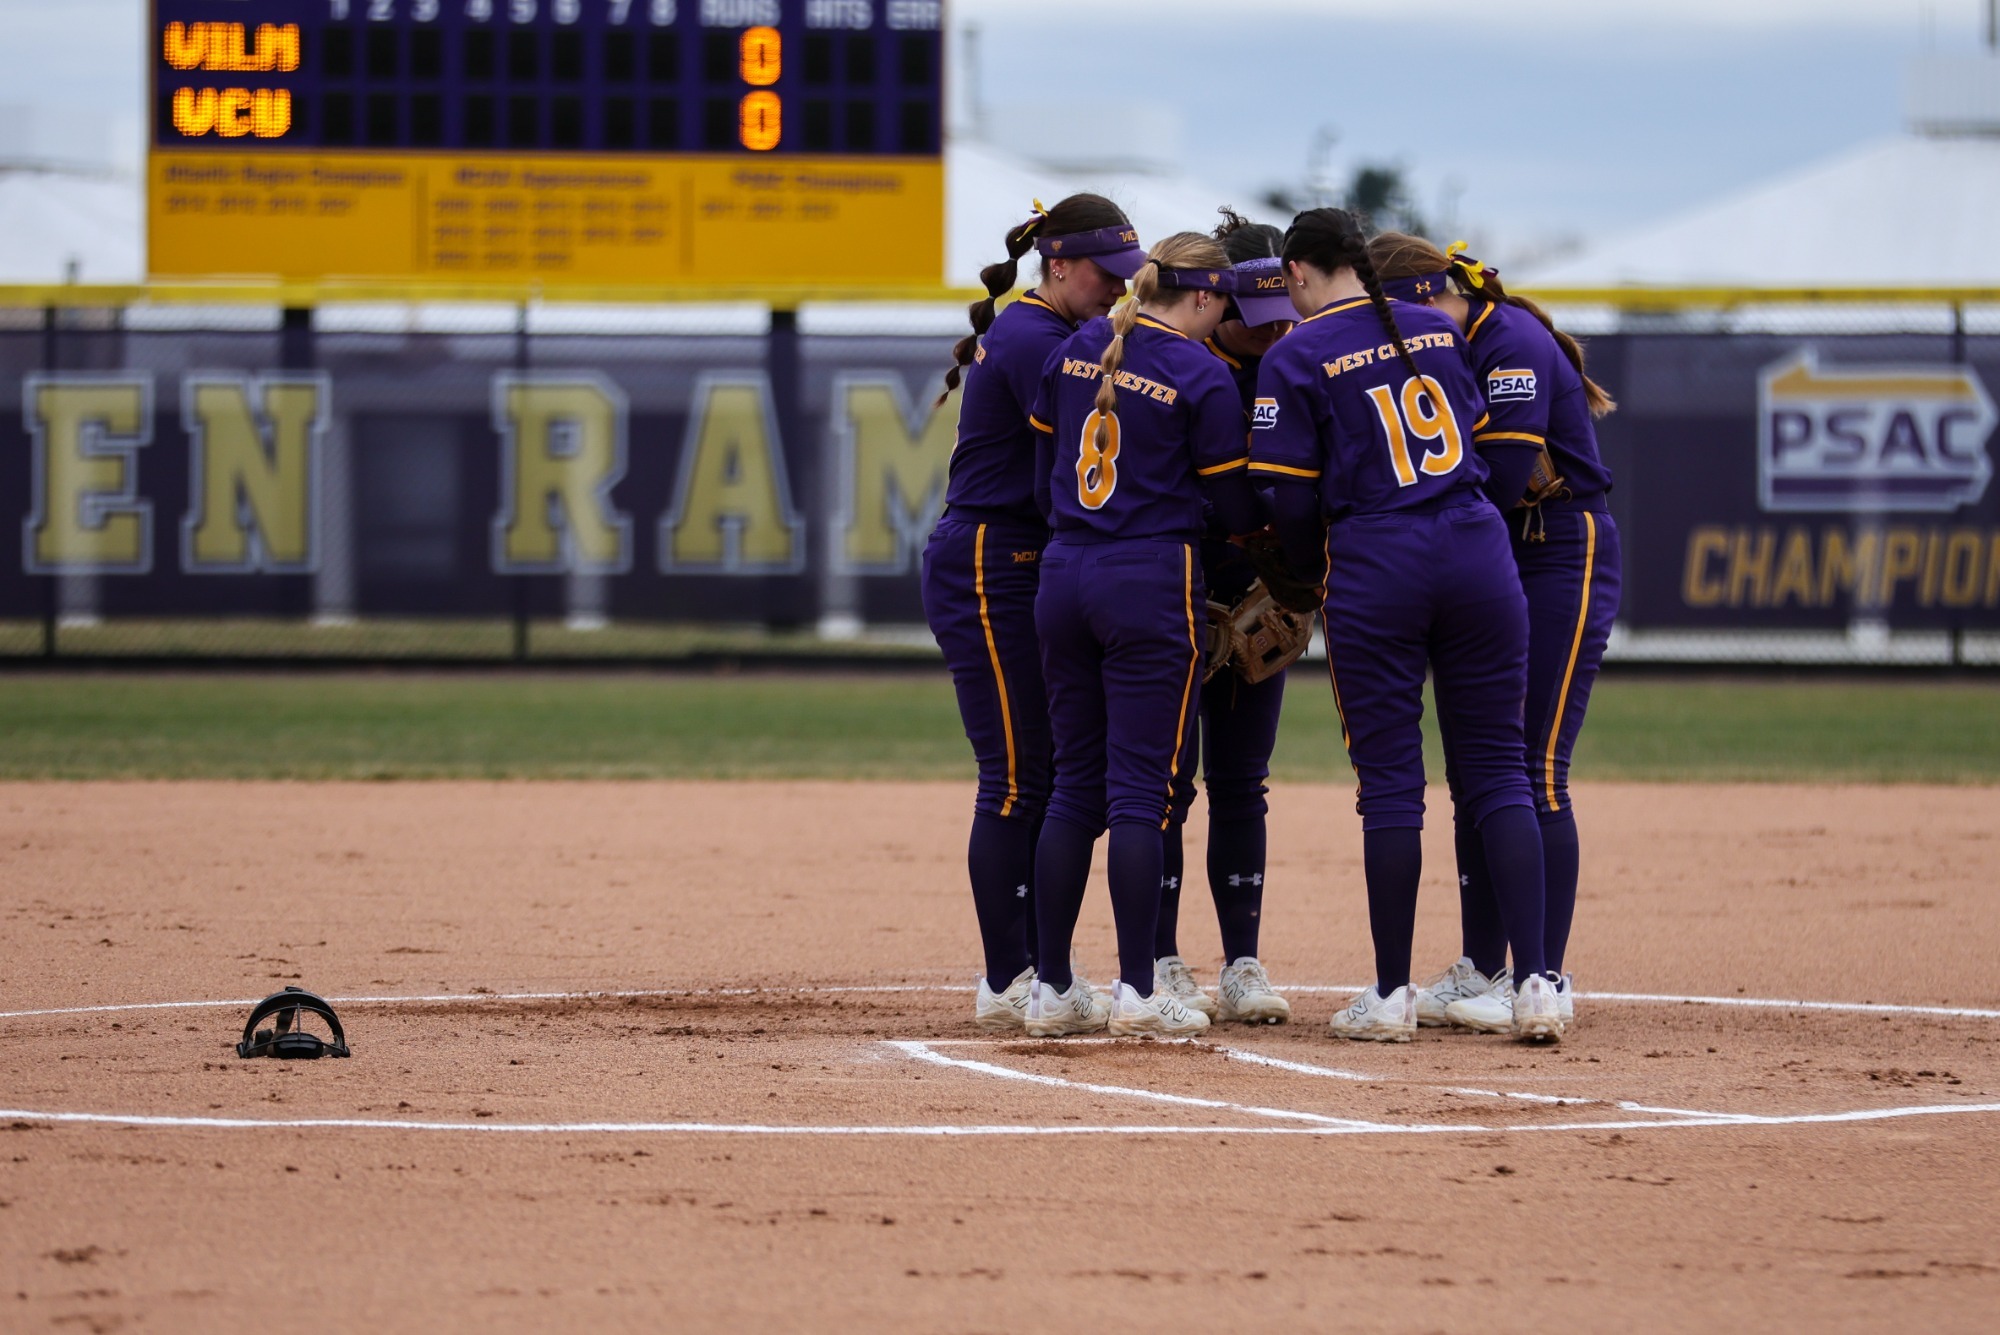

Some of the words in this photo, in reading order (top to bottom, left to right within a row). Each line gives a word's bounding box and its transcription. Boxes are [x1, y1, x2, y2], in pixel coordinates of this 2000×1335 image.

[366, 0, 395, 22] 2
[410, 0, 439, 23] 3
[806, 0, 873, 29] HITS
[739, 26, 782, 85] 0
[739, 90, 782, 150] 0
[1119, 230, 1138, 243] WC
[1062, 357, 1103, 380] WEST
[1103, 369, 1178, 406] HESTER
[1322, 348, 1374, 378] WEST
[1489, 377, 1534, 394] PSAC
[1365, 374, 1463, 487] 19
[1771, 408, 1980, 466] PSAC
[24, 370, 331, 575] EN
[492, 370, 968, 575] RAM
[1076, 407, 1121, 511] 8
[1011, 551, 1038, 563] WCU
